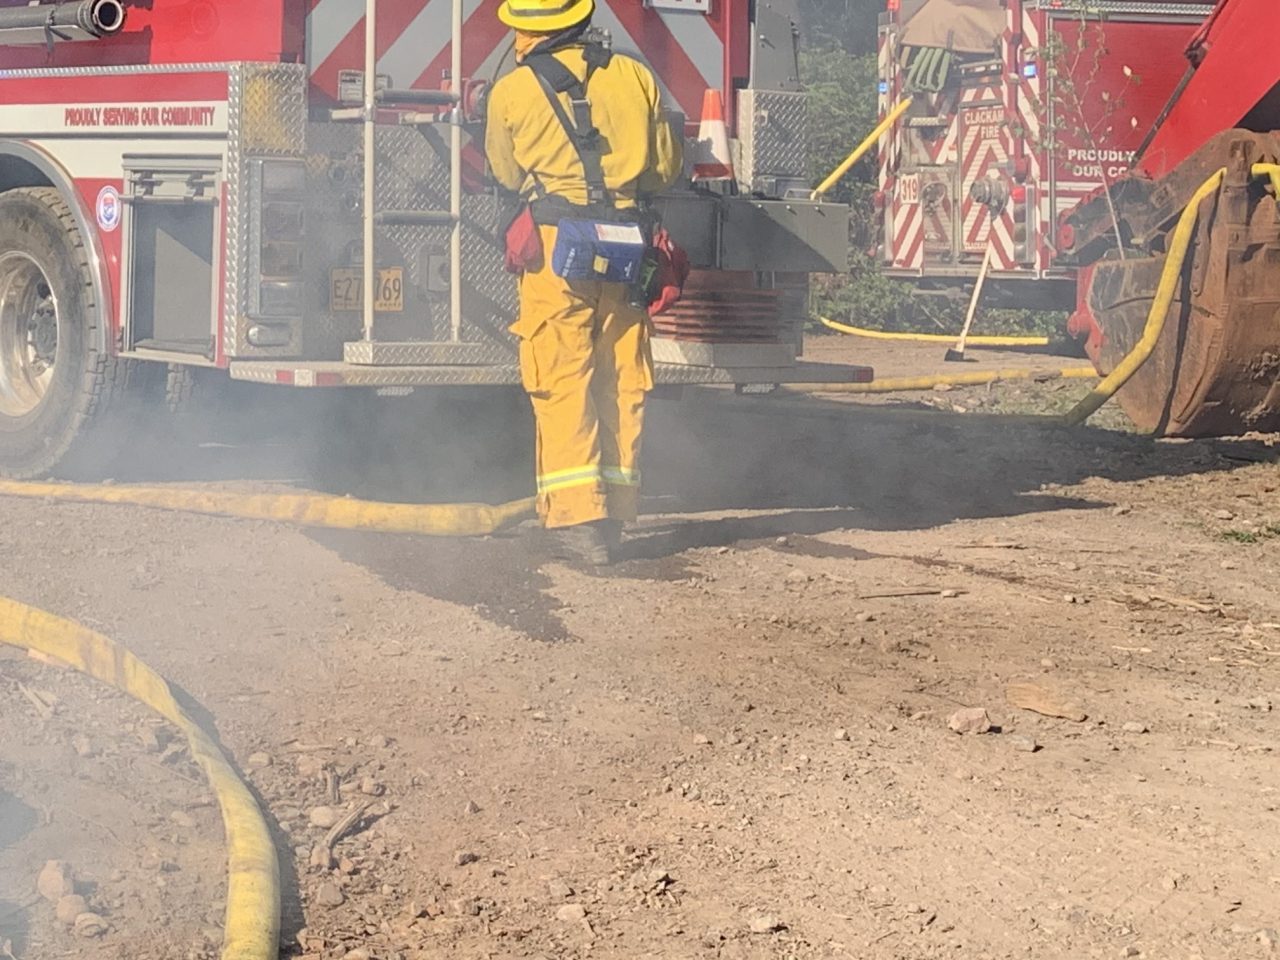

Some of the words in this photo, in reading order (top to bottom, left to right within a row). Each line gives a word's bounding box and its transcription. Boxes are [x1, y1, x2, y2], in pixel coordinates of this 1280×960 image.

[64, 107, 102, 126] PROUDLY
[103, 107, 139, 126] SERVING
[141, 106, 160, 126] OUR
[161, 106, 216, 126] COMMUNITY
[980, 125, 1001, 139] FIRE
[902, 179, 918, 201] 319
